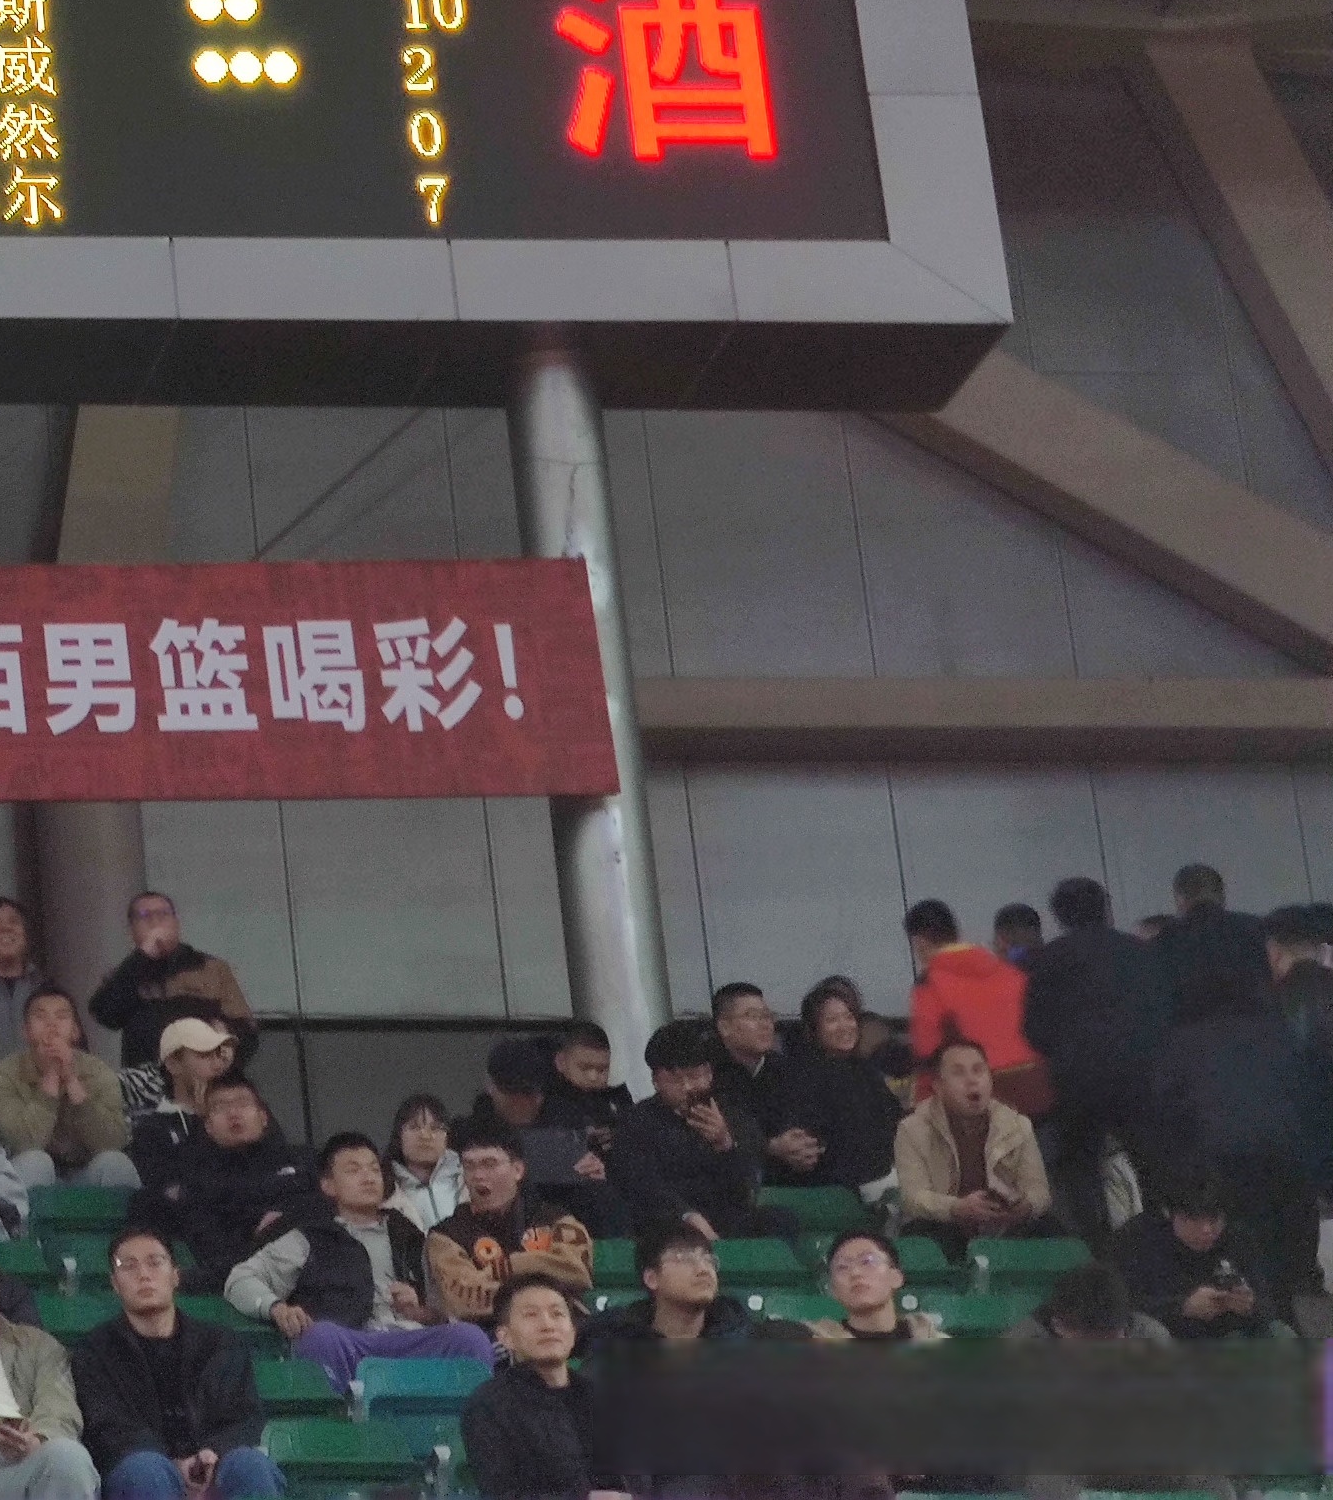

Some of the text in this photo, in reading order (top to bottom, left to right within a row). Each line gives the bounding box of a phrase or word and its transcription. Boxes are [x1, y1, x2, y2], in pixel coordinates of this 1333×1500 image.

[402, 45, 435, 93] 2
[408, 110, 443, 158] 0
[416, 176, 448, 225] 7
